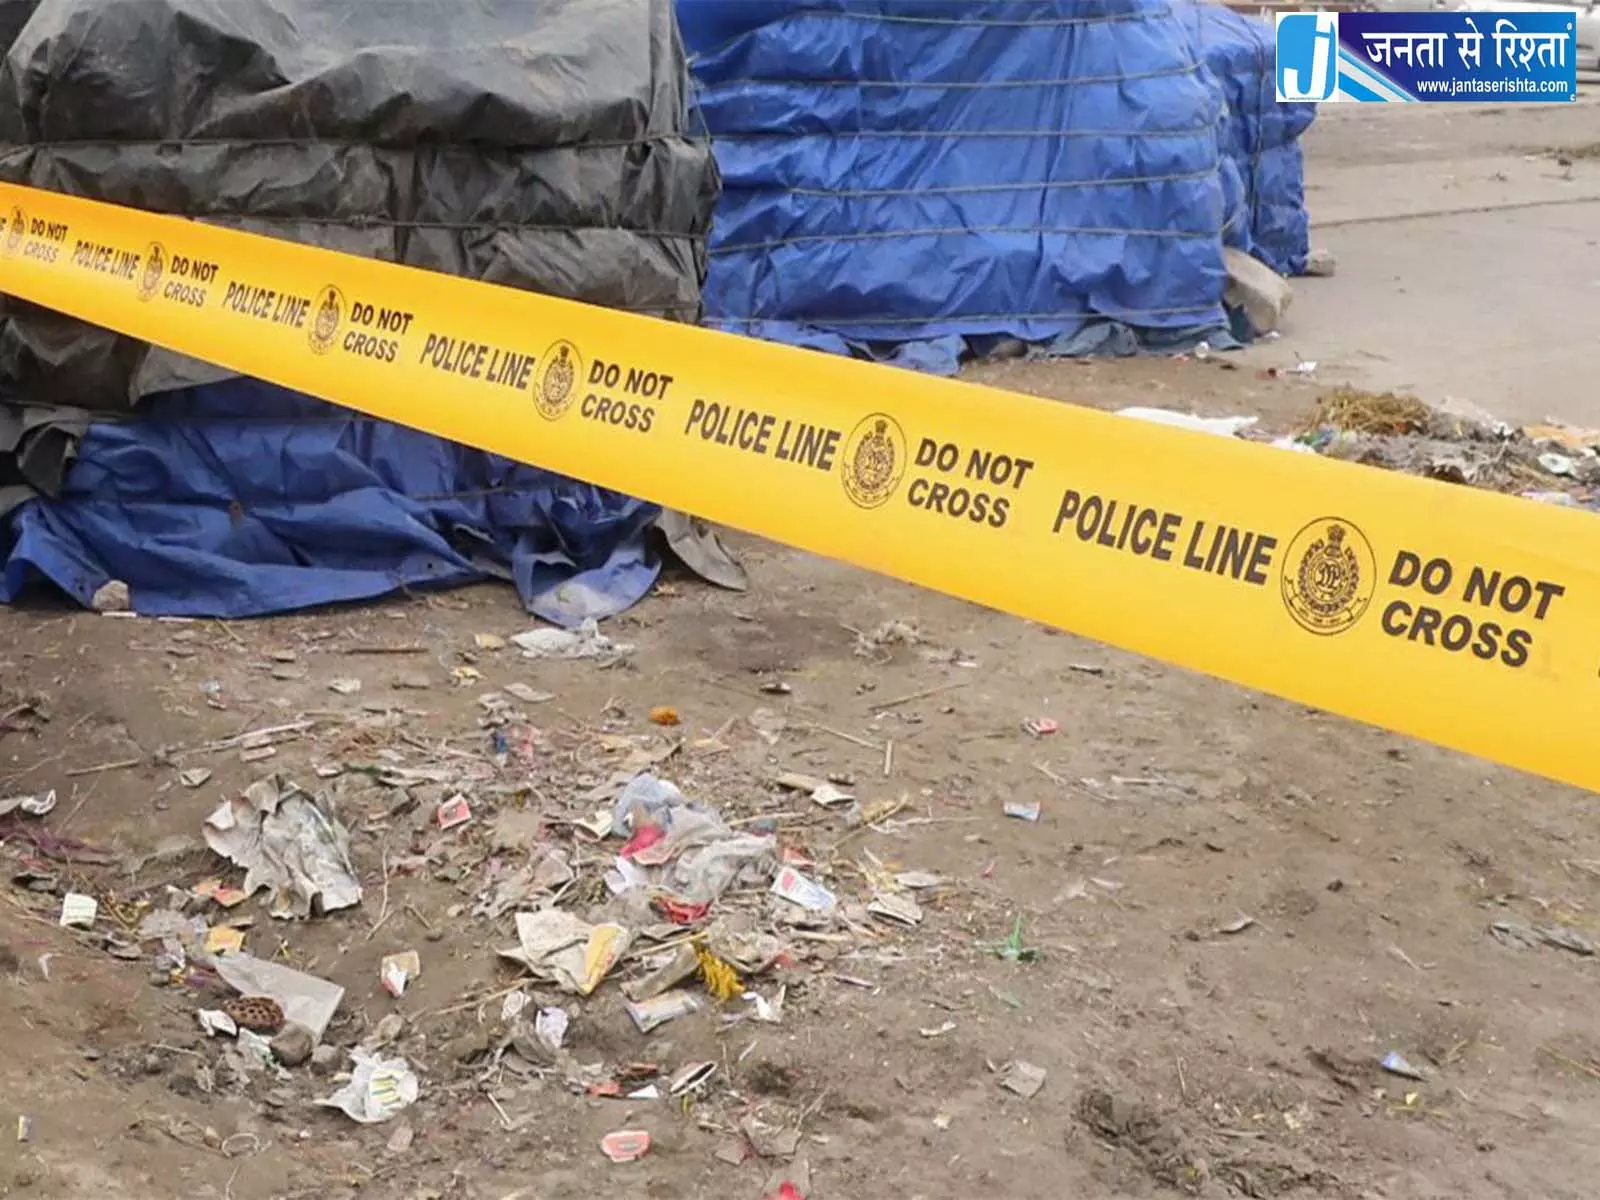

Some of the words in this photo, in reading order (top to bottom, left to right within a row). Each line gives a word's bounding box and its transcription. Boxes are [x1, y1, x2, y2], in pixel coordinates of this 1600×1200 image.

[31, 218, 45, 236] DO
[47, 222, 68, 242] NOT
[24, 240, 59, 263] CROSS
[71, 240, 113, 273] POLICE
[110, 250, 141, 280] LINE
[170, 255, 189, 275] DO
[190, 261, 219, 283] NOT
[163, 282, 207, 308] CROSS
[222, 281, 275, 319] POLICE
[272, 293, 310, 328] LINE
[350, 302, 373, 325] DO
[377, 309, 413, 335] NOT
[343, 331, 399, 363] CROSS
[420, 333, 489, 377] POLICE
[485, 345, 535, 390] LINE
[588, 359, 620, 388] DO
[624, 367, 673, 400] NOT
[580, 394, 655, 433] CROSS
[684, 399, 776, 454] POLICE
[774, 419, 842, 471] LINE
[914, 437, 959, 473] DO
[964, 448, 1034, 489] NOT
[907, 478, 1010, 529] CROSS
[1052, 489, 1183, 561] POLICE
[1183, 520, 1278, 586] LINE
[1388, 550, 1452, 595] DO
[1462, 566, 1565, 620] NOT
[1381, 600, 1533, 668] CROSS
